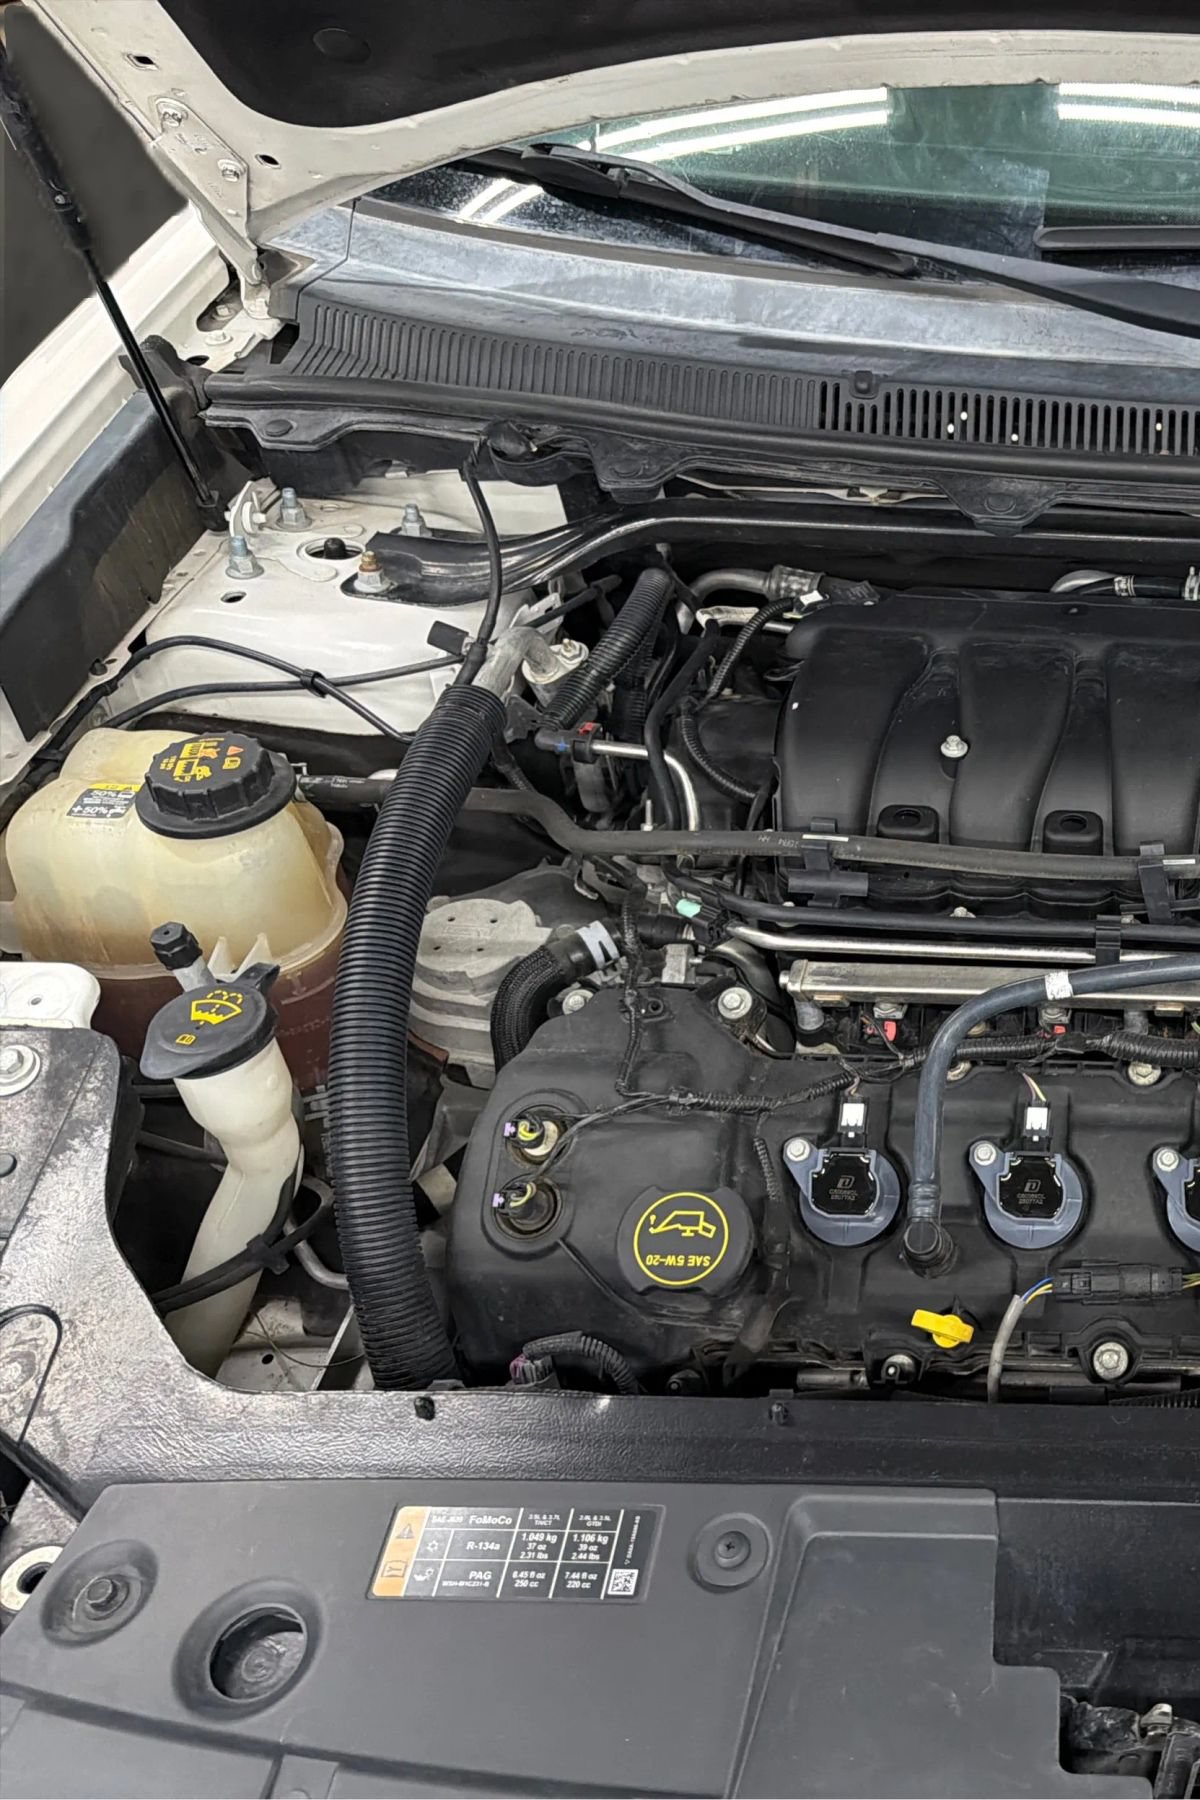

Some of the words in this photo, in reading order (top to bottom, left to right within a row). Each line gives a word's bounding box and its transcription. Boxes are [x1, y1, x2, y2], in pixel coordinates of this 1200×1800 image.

[83, 806, 109, 814] 50%
[645, 1254, 686, 1266] 5W-20
[687, 1255, 711, 1266] SAE
[469, 1515, 513, 1526] FoMoCo
[521, 1533, 545, 1542] 1.049
[545, 1533, 558, 1544] kg
[572, 1533, 596, 1542] 1.106
[597, 1534, 609, 1545] kg
[466, 1541, 501, 1551] R-134a
[520, 1551, 536, 1559] 2.31
[536, 1552, 548, 1560] lbs
[588, 1553, 600, 1561] lbs
[468, 1571, 493, 1580] PAG
[564, 1571, 581, 1580] 7.44
[514, 1580, 528, 1588] 250
[566, 1580, 580, 1588] 220
